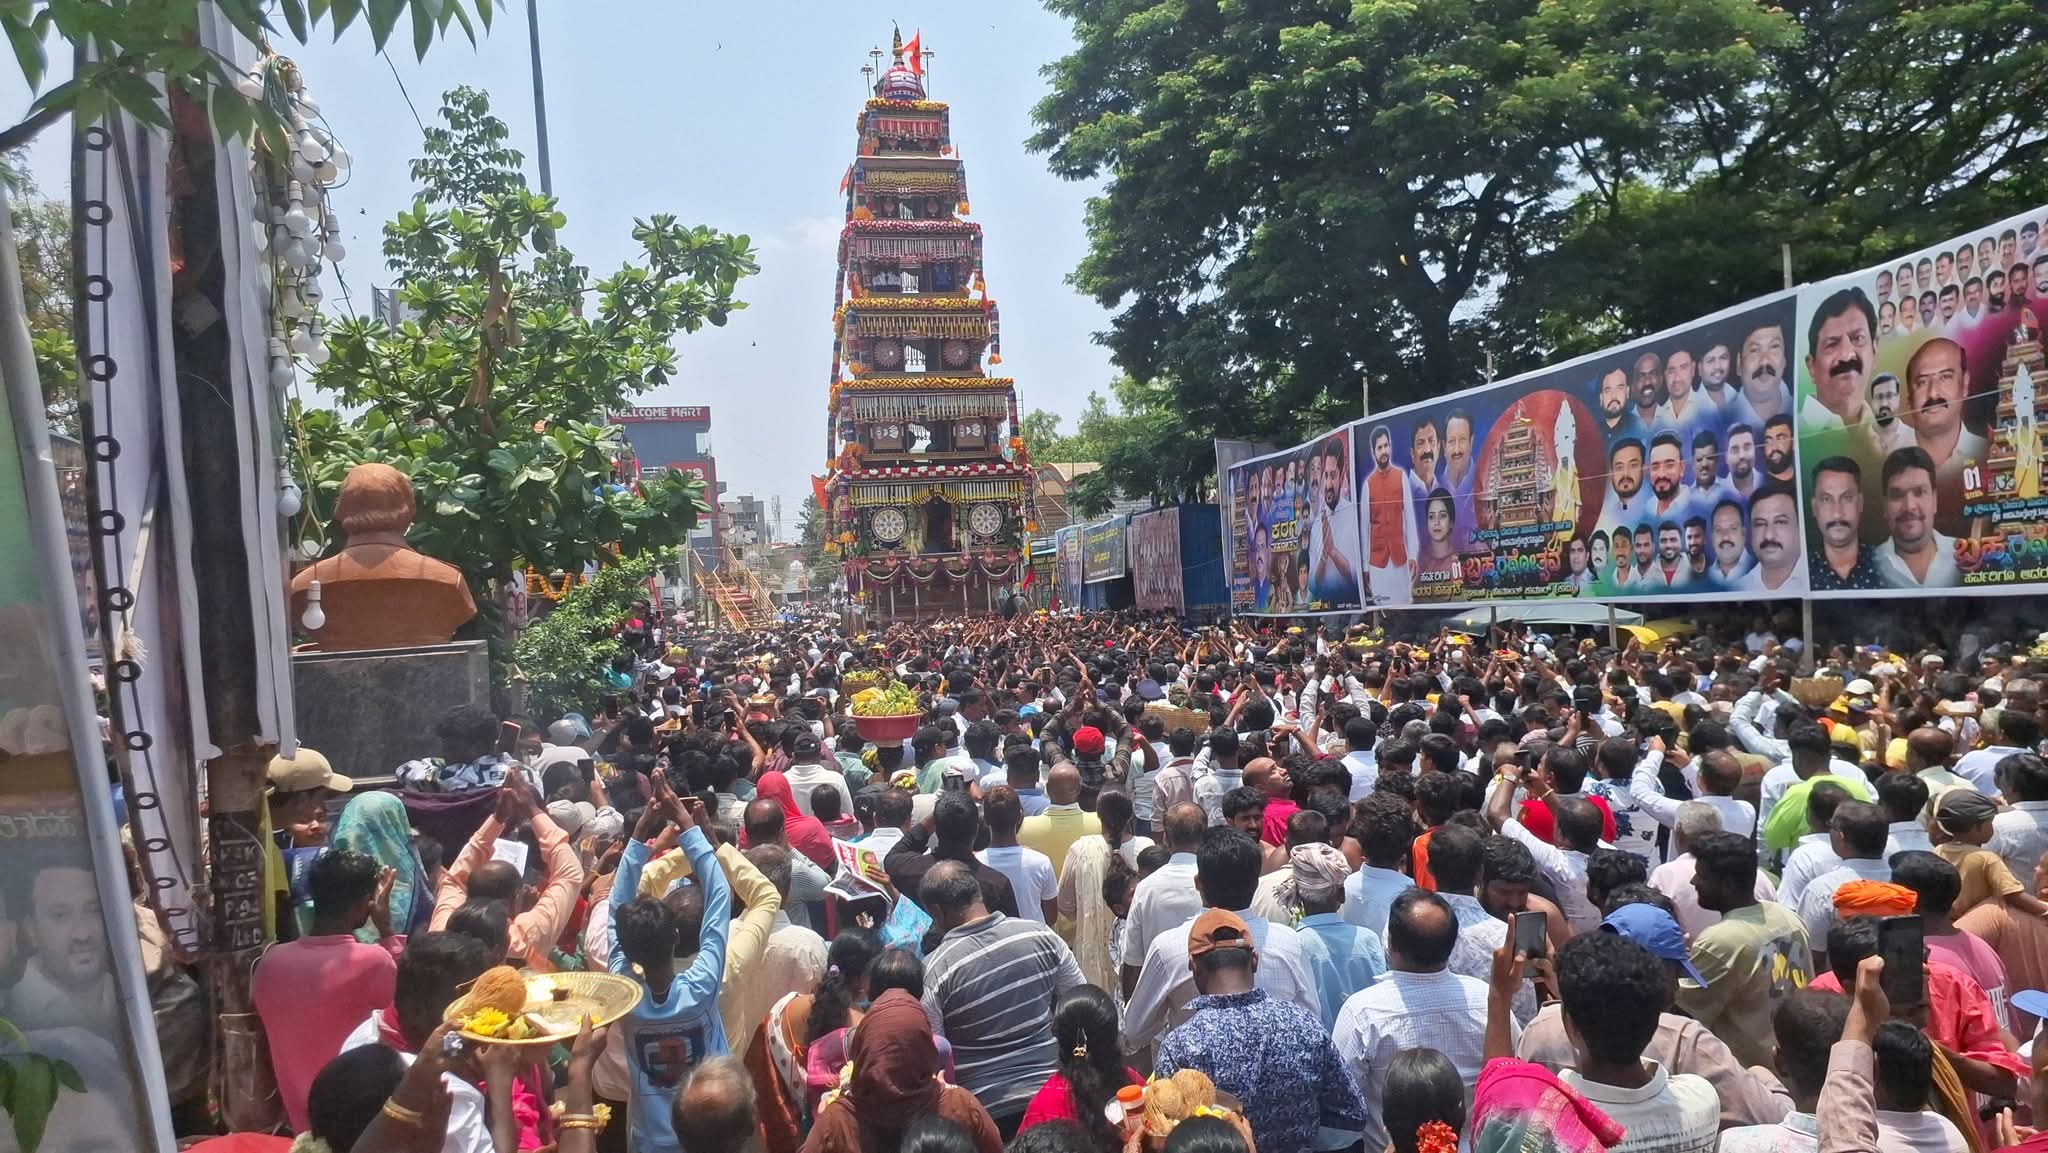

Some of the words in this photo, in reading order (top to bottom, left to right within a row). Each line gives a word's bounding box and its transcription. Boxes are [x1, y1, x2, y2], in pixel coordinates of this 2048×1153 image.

[671, 407, 702, 417] MART
[1963, 466, 1981, 490] 01
[1451, 561, 1462, 579] 01
